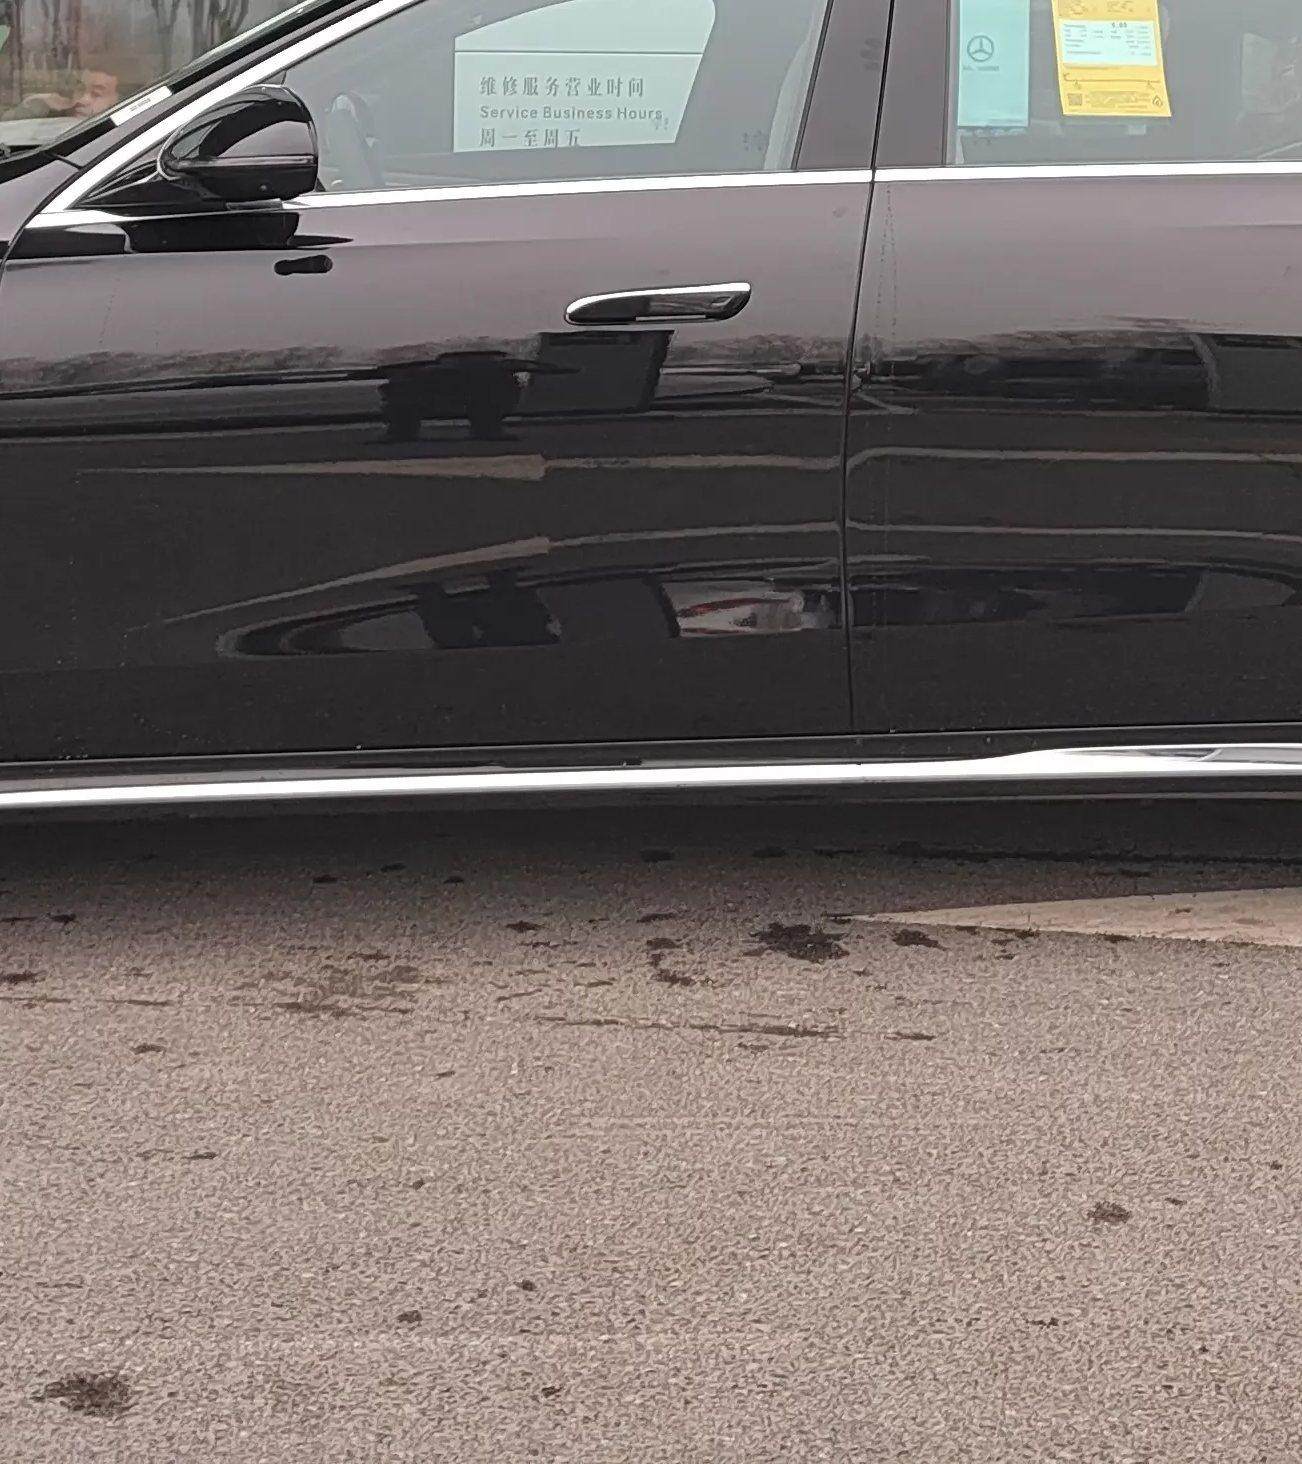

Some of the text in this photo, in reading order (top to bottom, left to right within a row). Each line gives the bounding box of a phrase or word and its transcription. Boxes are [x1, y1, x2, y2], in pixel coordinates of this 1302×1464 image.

[479, 75, 644, 98] 维修服务营业时间
[479, 105, 663, 121] Service Business Hours
[479, 127, 581, 148] 周一至周五
